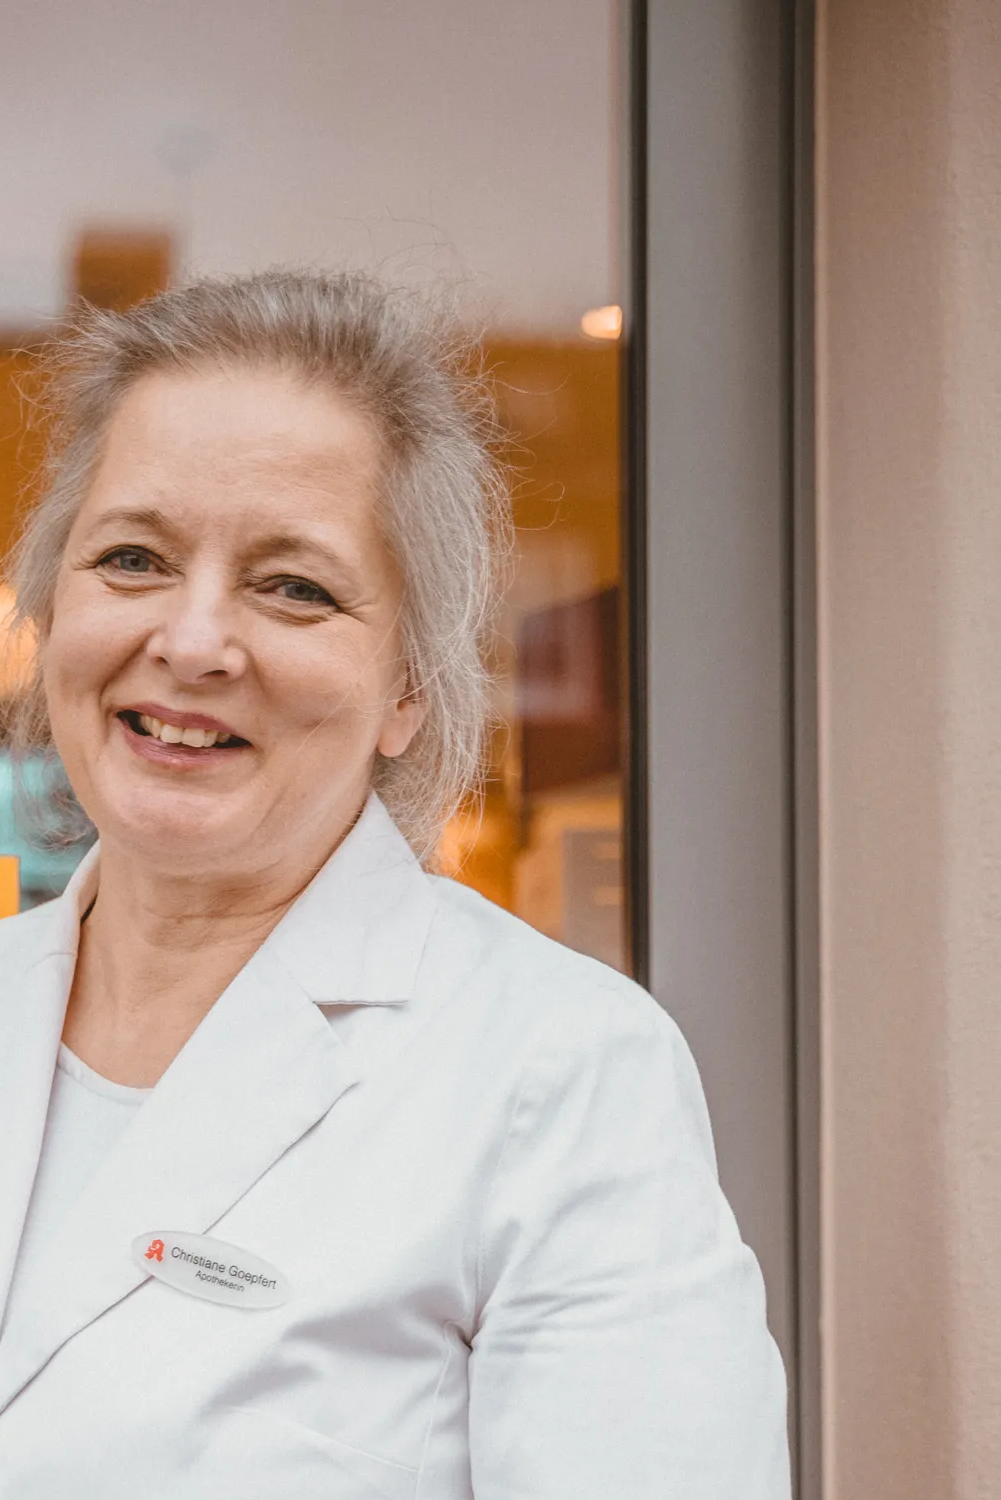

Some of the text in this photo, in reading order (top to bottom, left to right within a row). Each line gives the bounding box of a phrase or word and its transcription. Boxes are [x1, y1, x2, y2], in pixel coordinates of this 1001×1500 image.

[171, 1246, 226, 1273] Christiane
[228, 1265, 277, 1290] Goepfert
[195, 1270, 245, 1292] Apothekerin
